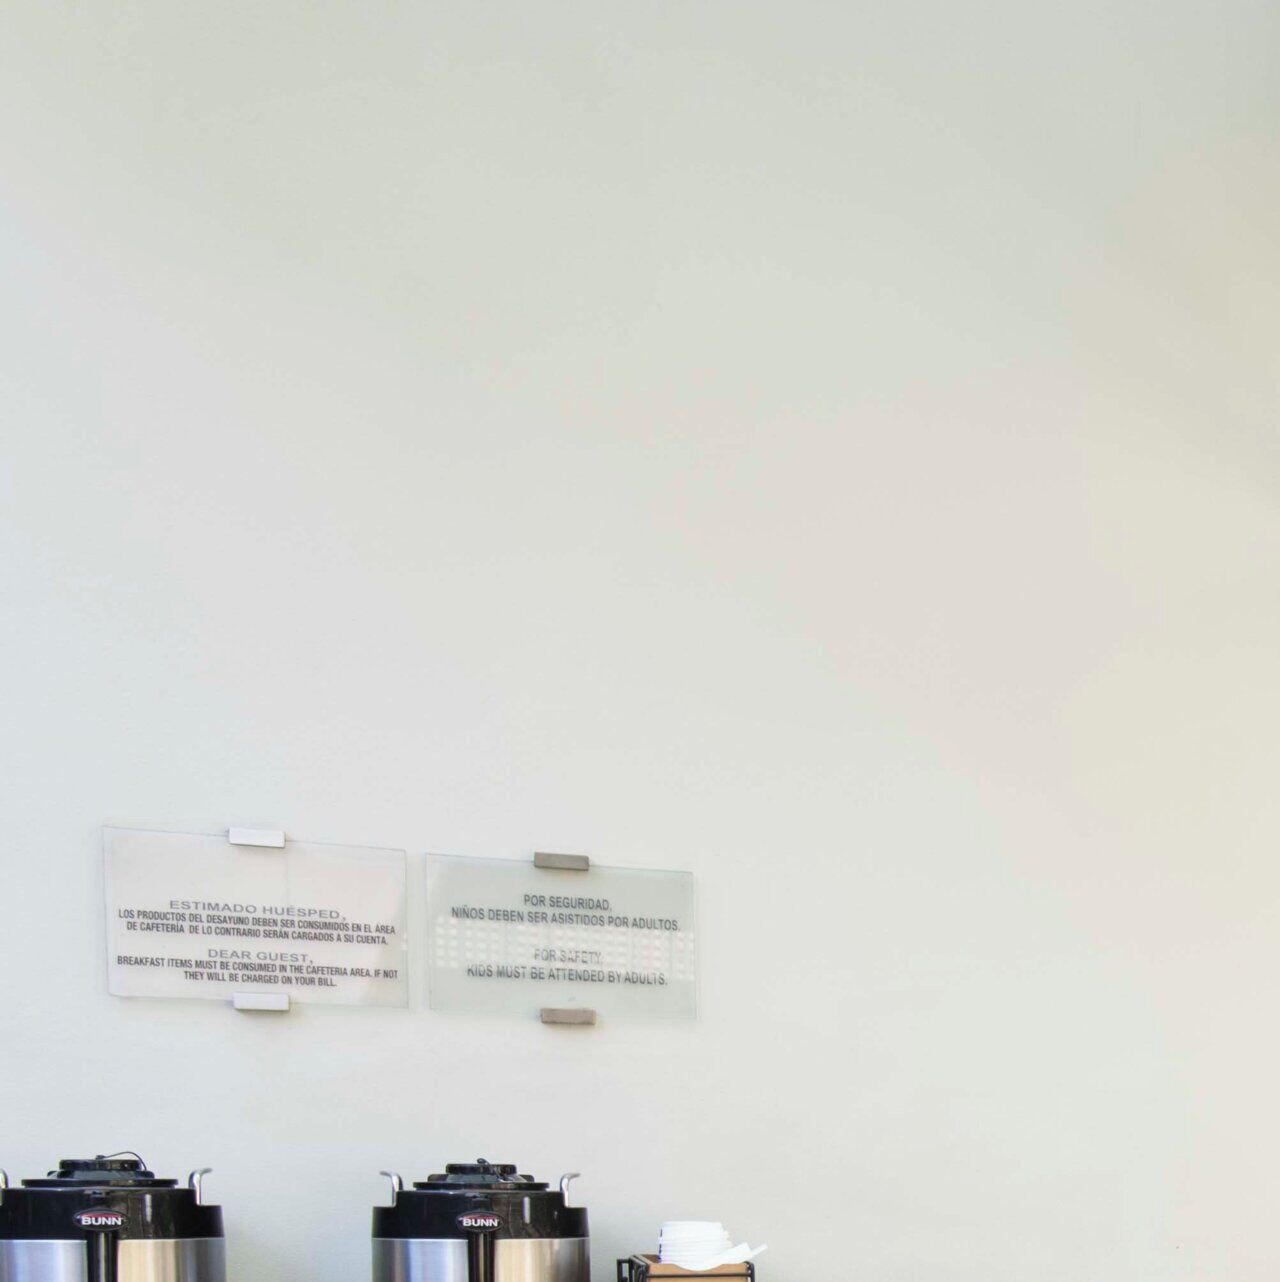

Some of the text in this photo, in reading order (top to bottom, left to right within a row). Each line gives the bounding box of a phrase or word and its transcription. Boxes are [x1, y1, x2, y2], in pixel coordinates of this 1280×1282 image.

[523, 894, 546, 907] POR
[169, 900, 347, 920] ESTIMADO HUÉSPED,
[451, 904, 681, 931] NIÑOS DEBEN SER ASISTIDOS POR ADULTOS.
[118, 908, 396, 935] LOS PRODUCTOS DEL DESAYUNO DEBEN SER CONSUMIDOS EN EL ÁREA
[126, 921, 389, 945] DE CAFETERÍA DE LO CONTRARIO SERÁN CARGADOS A SU CUENTA.
[207, 949, 314, 965] DEAR GUEST,
[533, 949, 556, 962] FOR
[117, 955, 165, 967] BREAKFAST
[167, 957, 193, 968] ITEMS
[194, 959, 218, 970] MUST
[220, 961, 231, 971] BE
[232, 961, 277, 973] CONSUMED
[279, 963, 288, 973] IN
[289, 964, 304, 974] THE
[306, 965, 348, 977] CAFETERIA
[374, 969, 382, 978] IF
[383, 969, 399, 980] NOT
[466, 963, 493, 977] KIDS
[496, 965, 527, 979] MUST
[530, 966, 546, 980] BE
[548, 967, 604, 982] ATTENDED
[608, 970, 622, 984] BY
[183, 970, 337, 987] THEY WILL BE CHARGED ON YOUR BILL.
[79, 1214, 123, 1226] BUNN
[461, 1217, 499, 1227] BUNN
